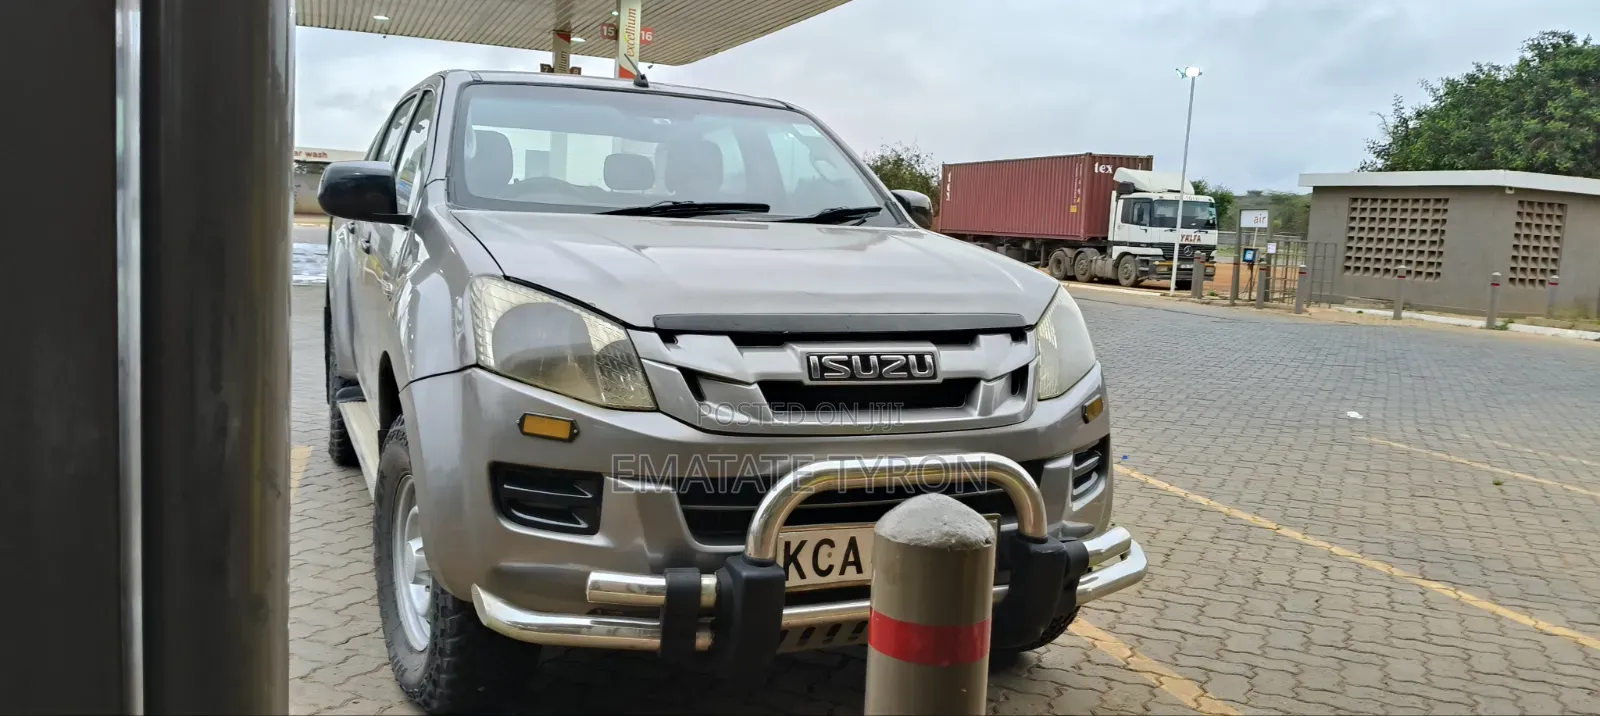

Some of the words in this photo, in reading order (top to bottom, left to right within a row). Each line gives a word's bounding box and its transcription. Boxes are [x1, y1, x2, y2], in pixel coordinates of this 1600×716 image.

[602, 26, 615, 37] 15
[625, 8, 637, 57] excellium
[641, 31, 653, 41] 16
[1094, 161, 1113, 173] tex
[1253, 213, 1266, 224] air
[809, 354, 934, 379] ISUZU
[782, 535, 864, 581] KCA
